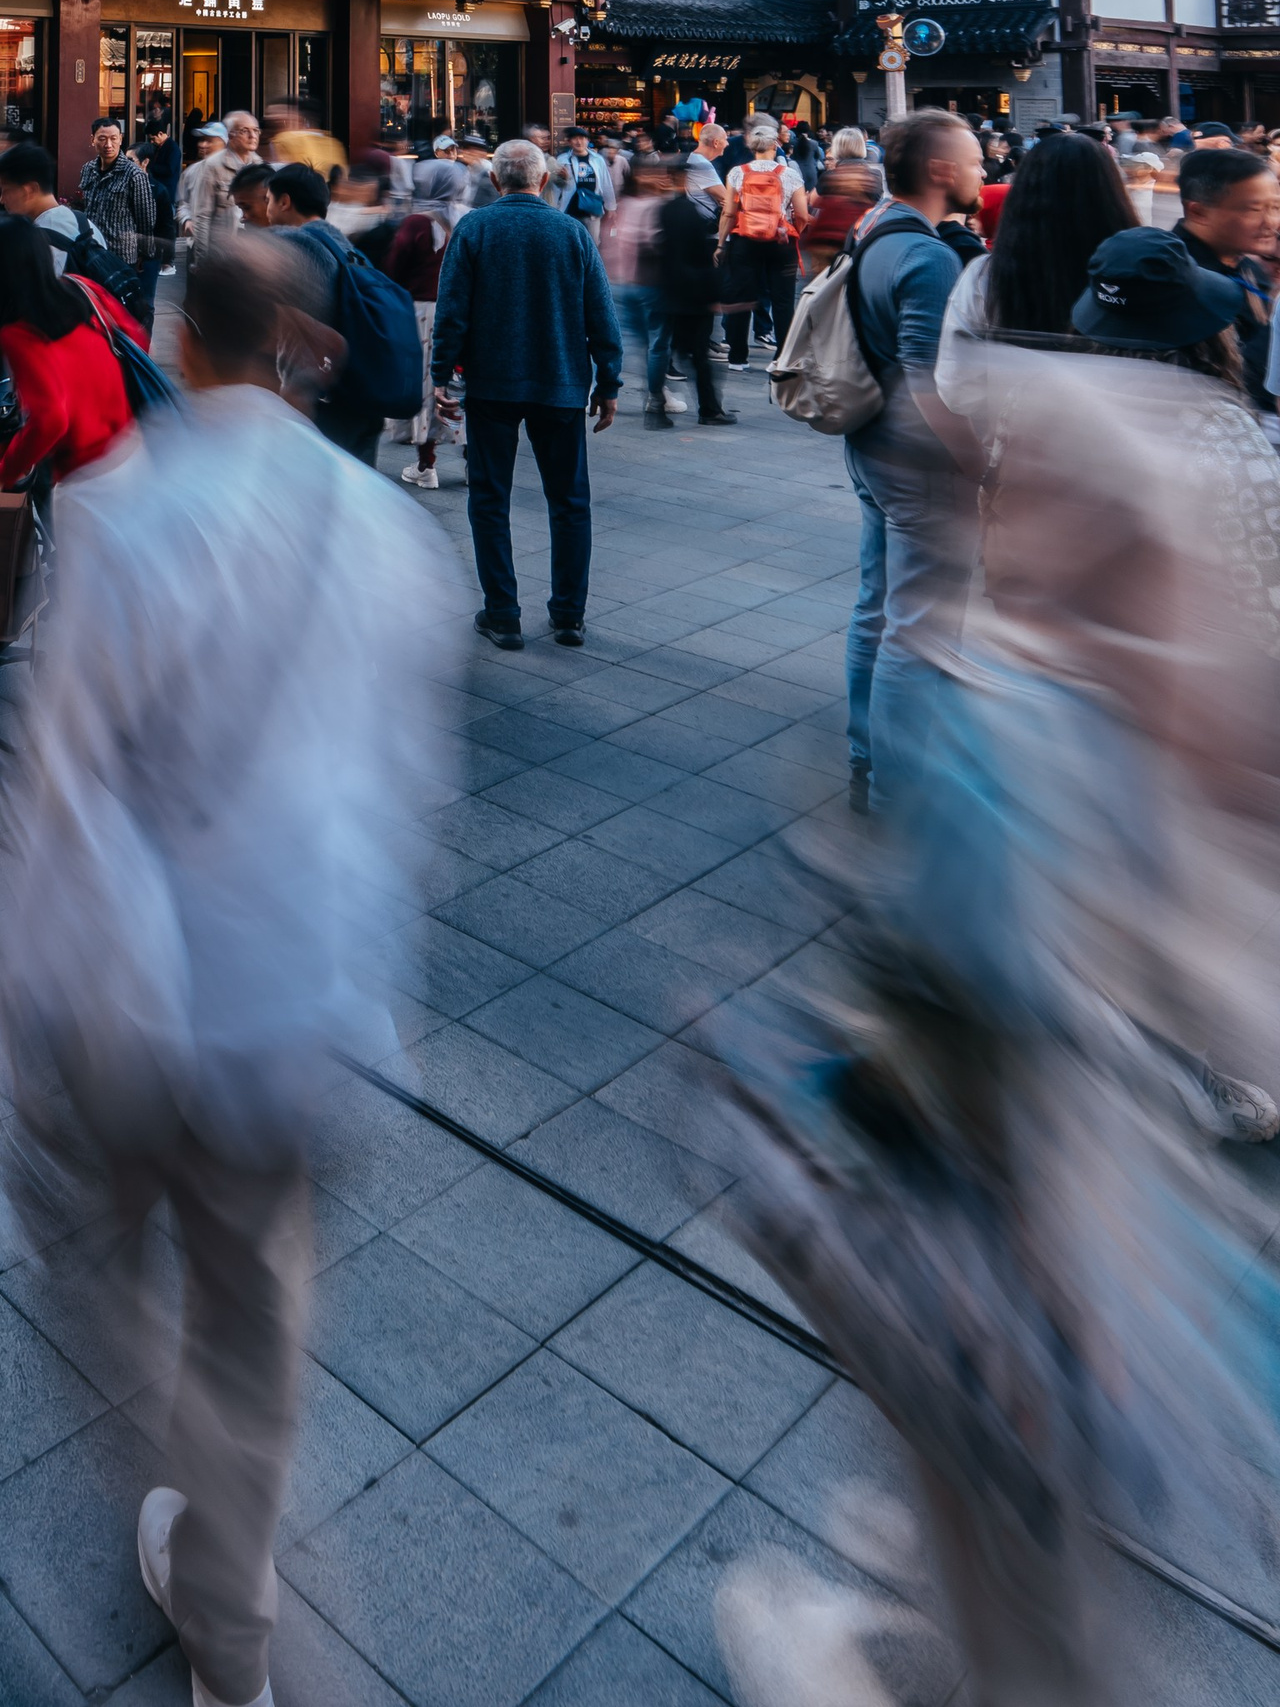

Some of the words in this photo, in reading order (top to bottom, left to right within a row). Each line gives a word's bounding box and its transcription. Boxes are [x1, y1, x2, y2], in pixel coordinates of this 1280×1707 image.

[427, 12, 451, 21] LAOPU
[452, 14, 471, 22] GOLD
[1097, 291, 1127, 306] ROXY
